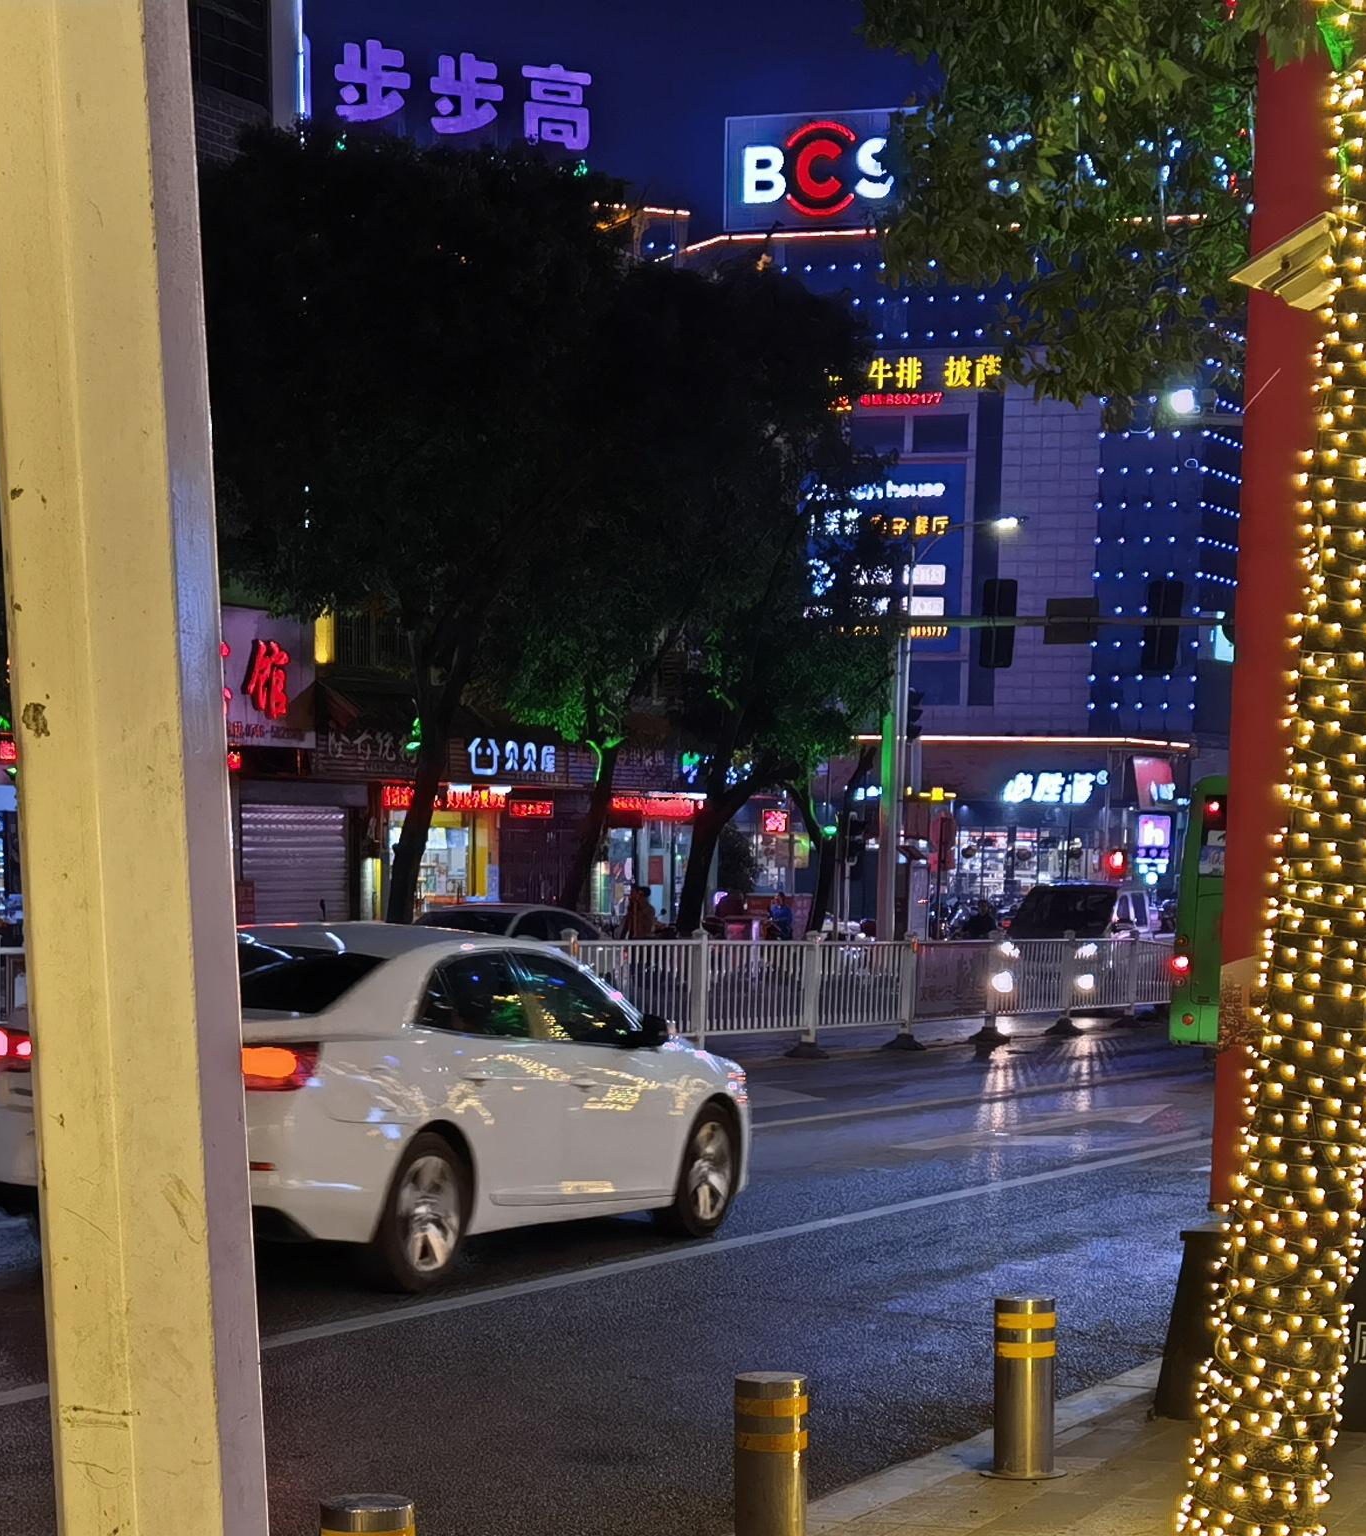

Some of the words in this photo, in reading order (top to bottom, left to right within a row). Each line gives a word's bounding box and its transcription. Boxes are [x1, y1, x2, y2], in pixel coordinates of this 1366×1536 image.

[335, 39, 592, 150] 步步高
[742, 134, 895, 206] BCS
[868, 356, 923, 389] 牛排
[944, 354, 1003, 389] 披萨
[870, 514, 950, 536] 子餐厅
[504, 740, 556, 773] 贝贝屋
